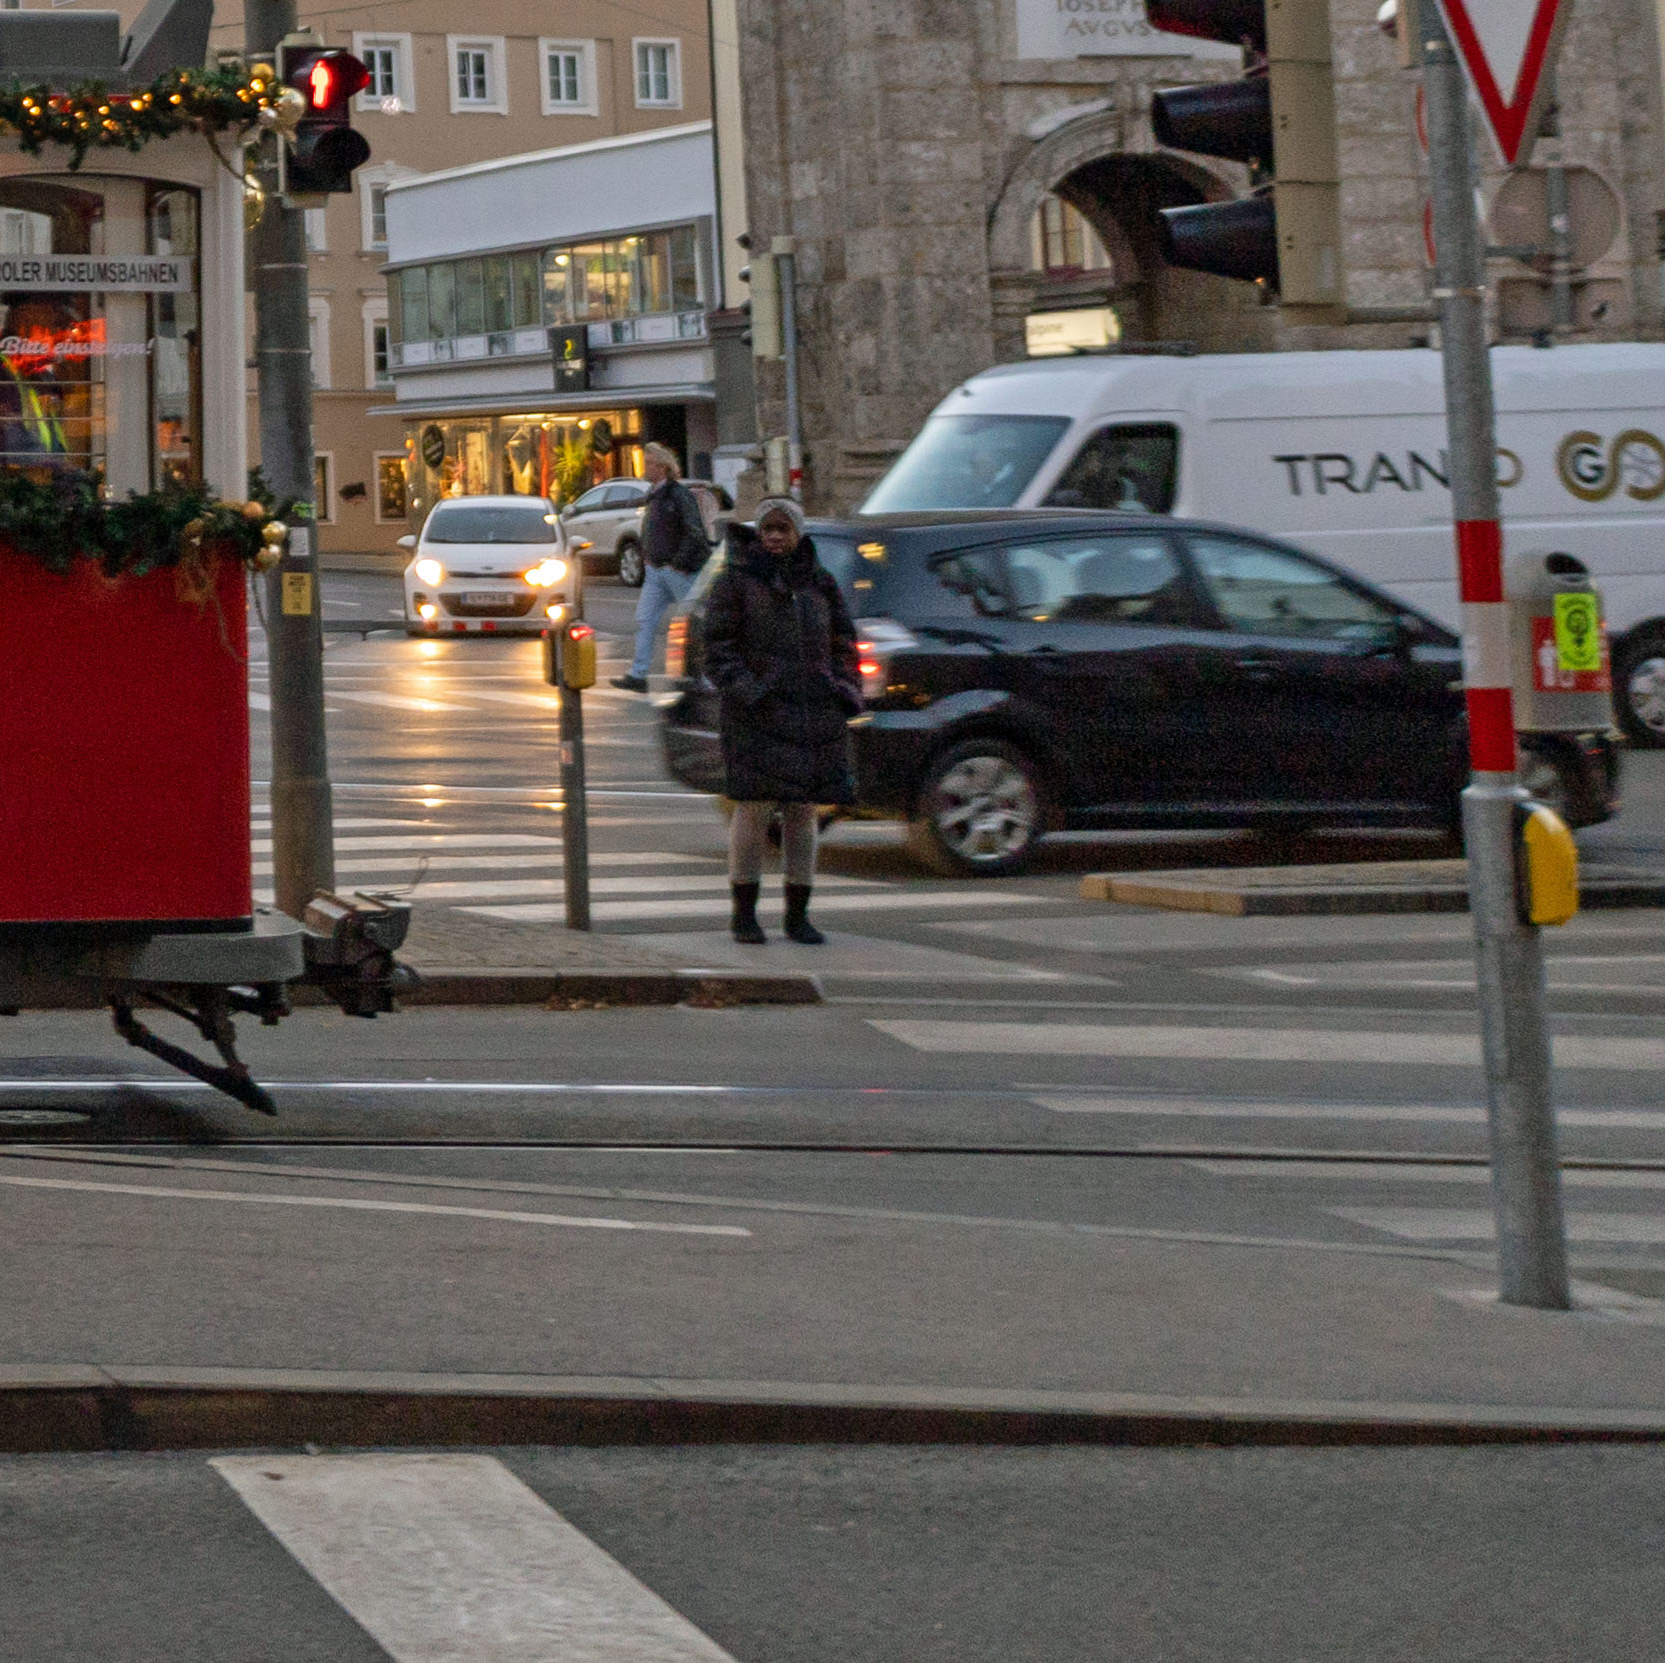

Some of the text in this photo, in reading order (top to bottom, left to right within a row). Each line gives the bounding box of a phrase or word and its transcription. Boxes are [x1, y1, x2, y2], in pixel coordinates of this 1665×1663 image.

[45, 261, 179, 284] MUSEUMSBAHNEN
[0, 336, 154, 358] Bitte einsteigen!
